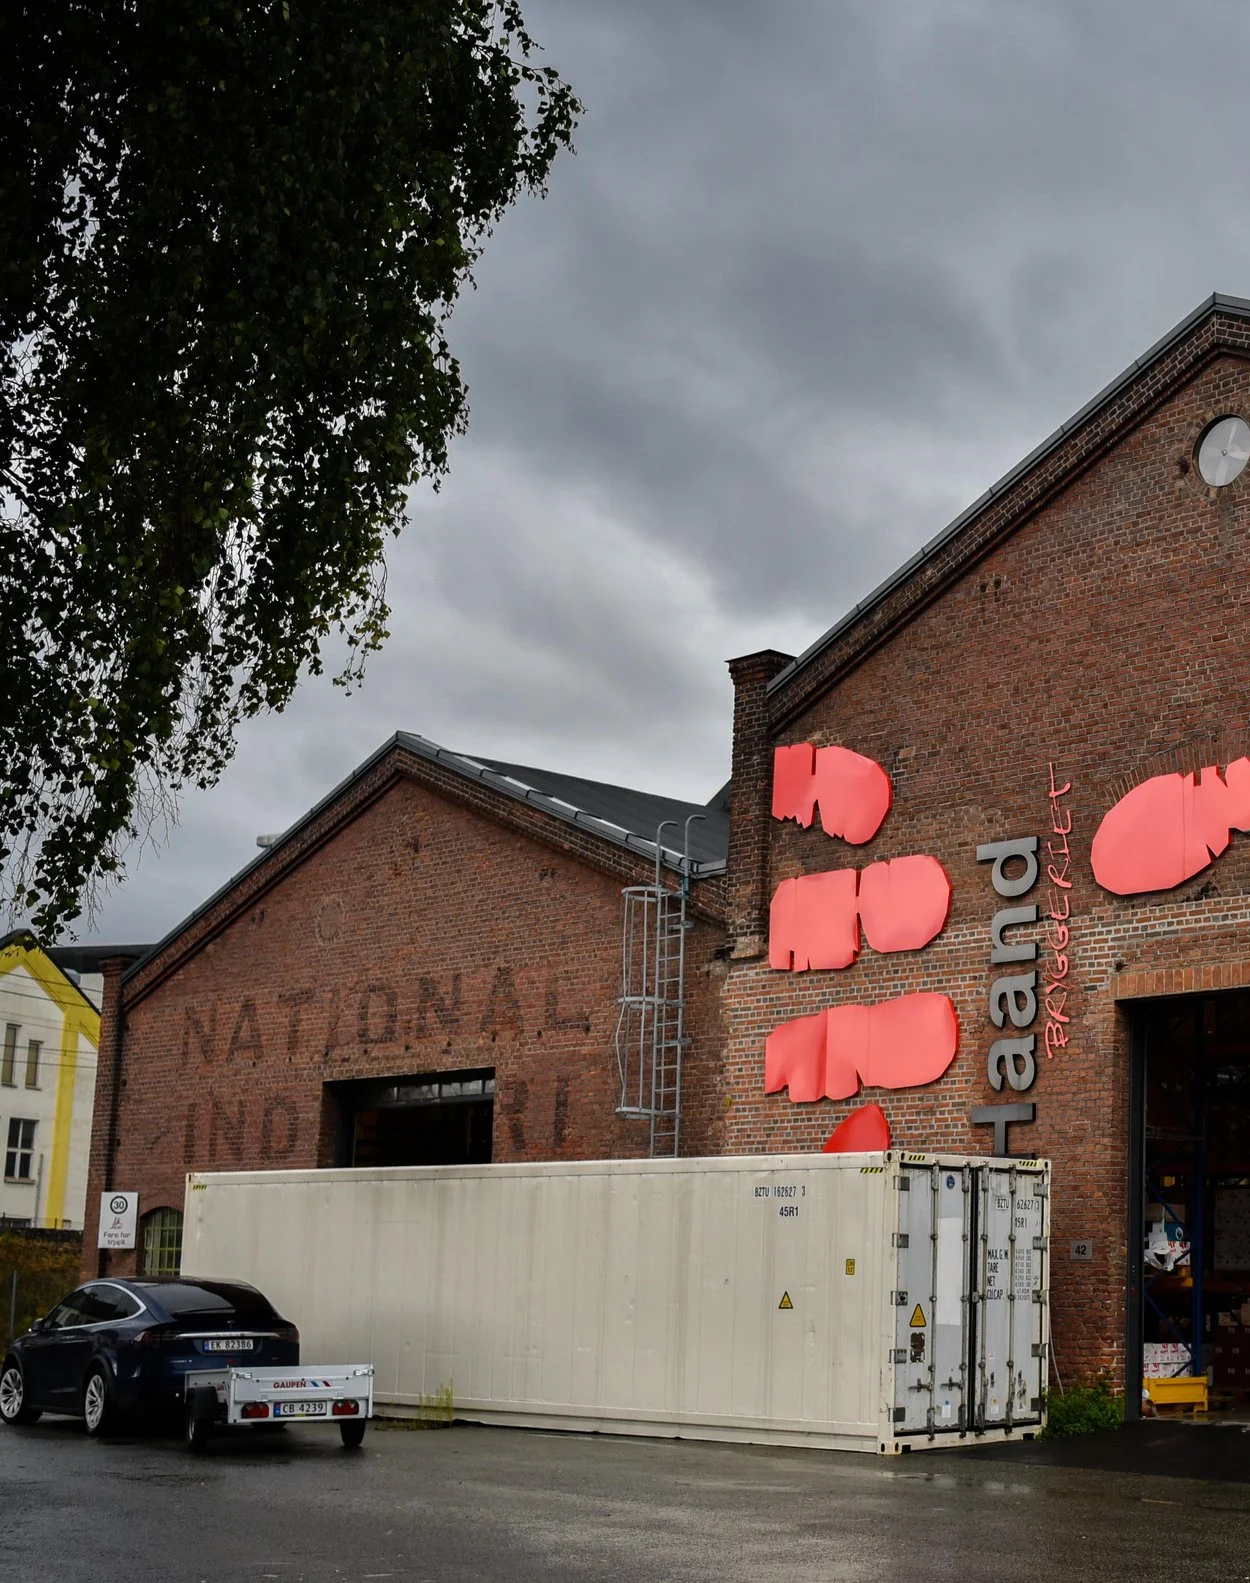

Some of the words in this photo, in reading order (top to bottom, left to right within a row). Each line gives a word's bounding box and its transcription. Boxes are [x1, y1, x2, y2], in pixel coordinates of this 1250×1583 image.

[1043, 761, 1073, 1060] BRYGGERIET
[972, 835, 1039, 1159] Haand
[181, 966, 592, 1066] NATIONAL
[773, 1186, 796, 1197] 162627
[801, 1185, 806, 1196] 3
[113, 1201, 125, 1210] 30
[1016, 1199, 1034, 1210] 62627
[779, 1206, 799, 1217] 45R1
[1074, 1245, 1087, 1256] 42
[987, 1262, 999, 1274] TARE
[986, 1275, 996, 1287] NET
[210, 1339, 221, 1349] EK
[224, 1339, 252, 1349] 82386
[273, 1379, 307, 1389] GAUPEN
[282, 1404, 295, 1414] CB
[299, 1403, 324, 1413] 4239
